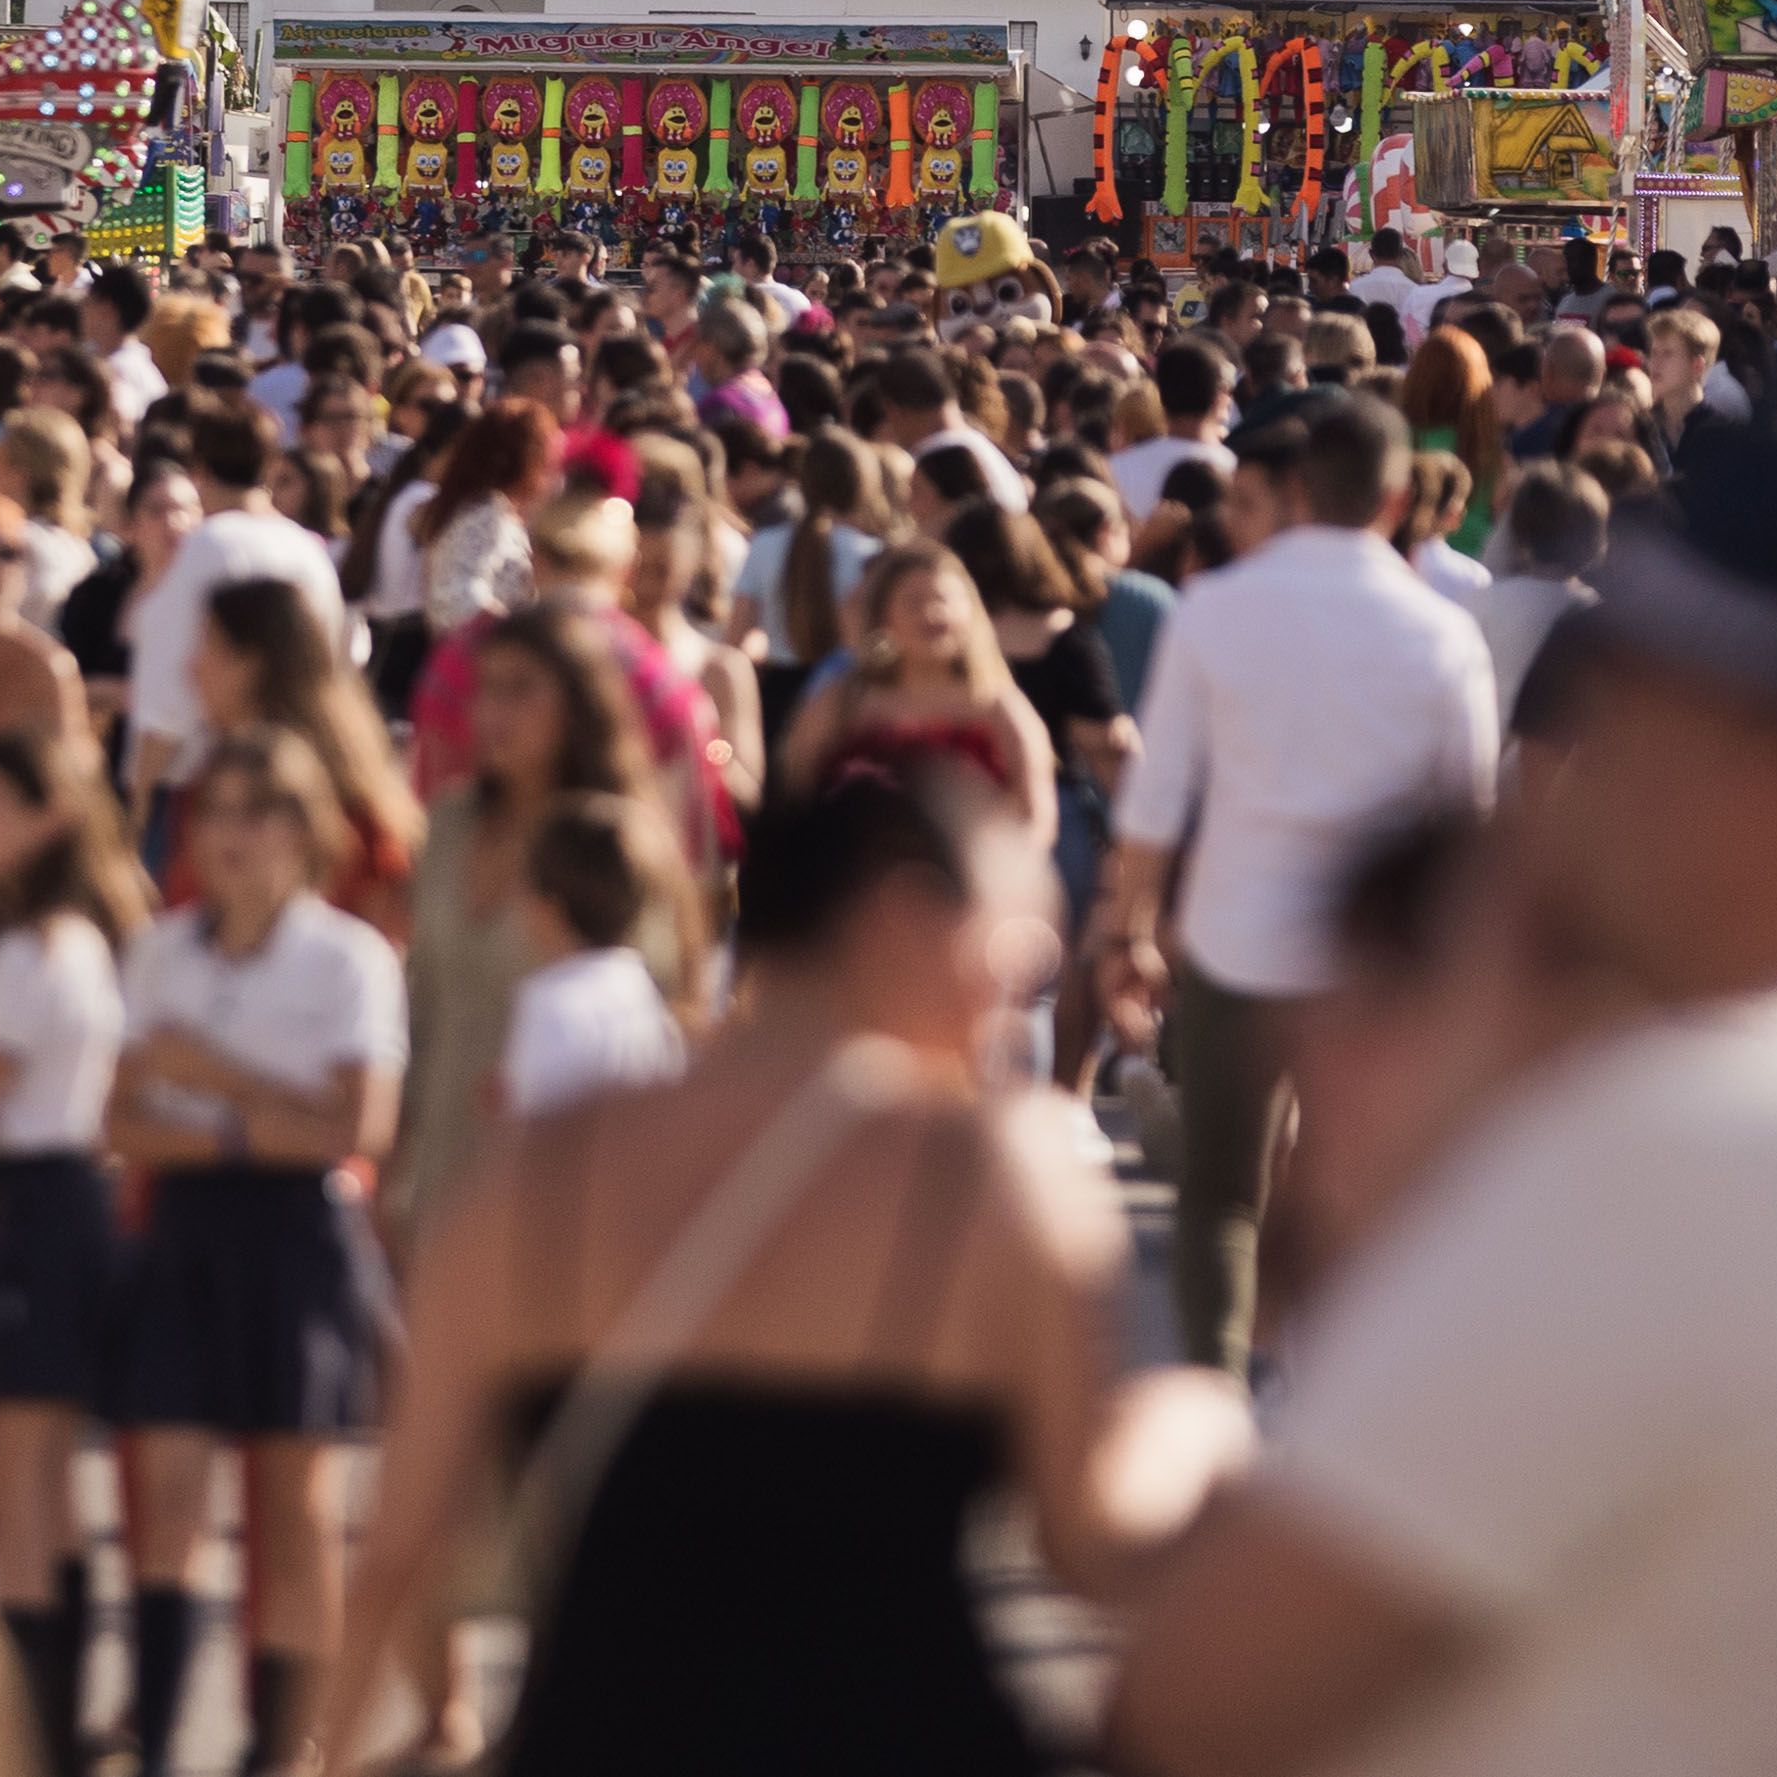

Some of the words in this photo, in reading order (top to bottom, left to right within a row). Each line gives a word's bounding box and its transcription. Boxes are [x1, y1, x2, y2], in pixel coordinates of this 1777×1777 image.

[279, 24, 430, 41] Atracciones
[474, 30, 658, 56] Miguel
[679, 26, 835, 59] Ángel
